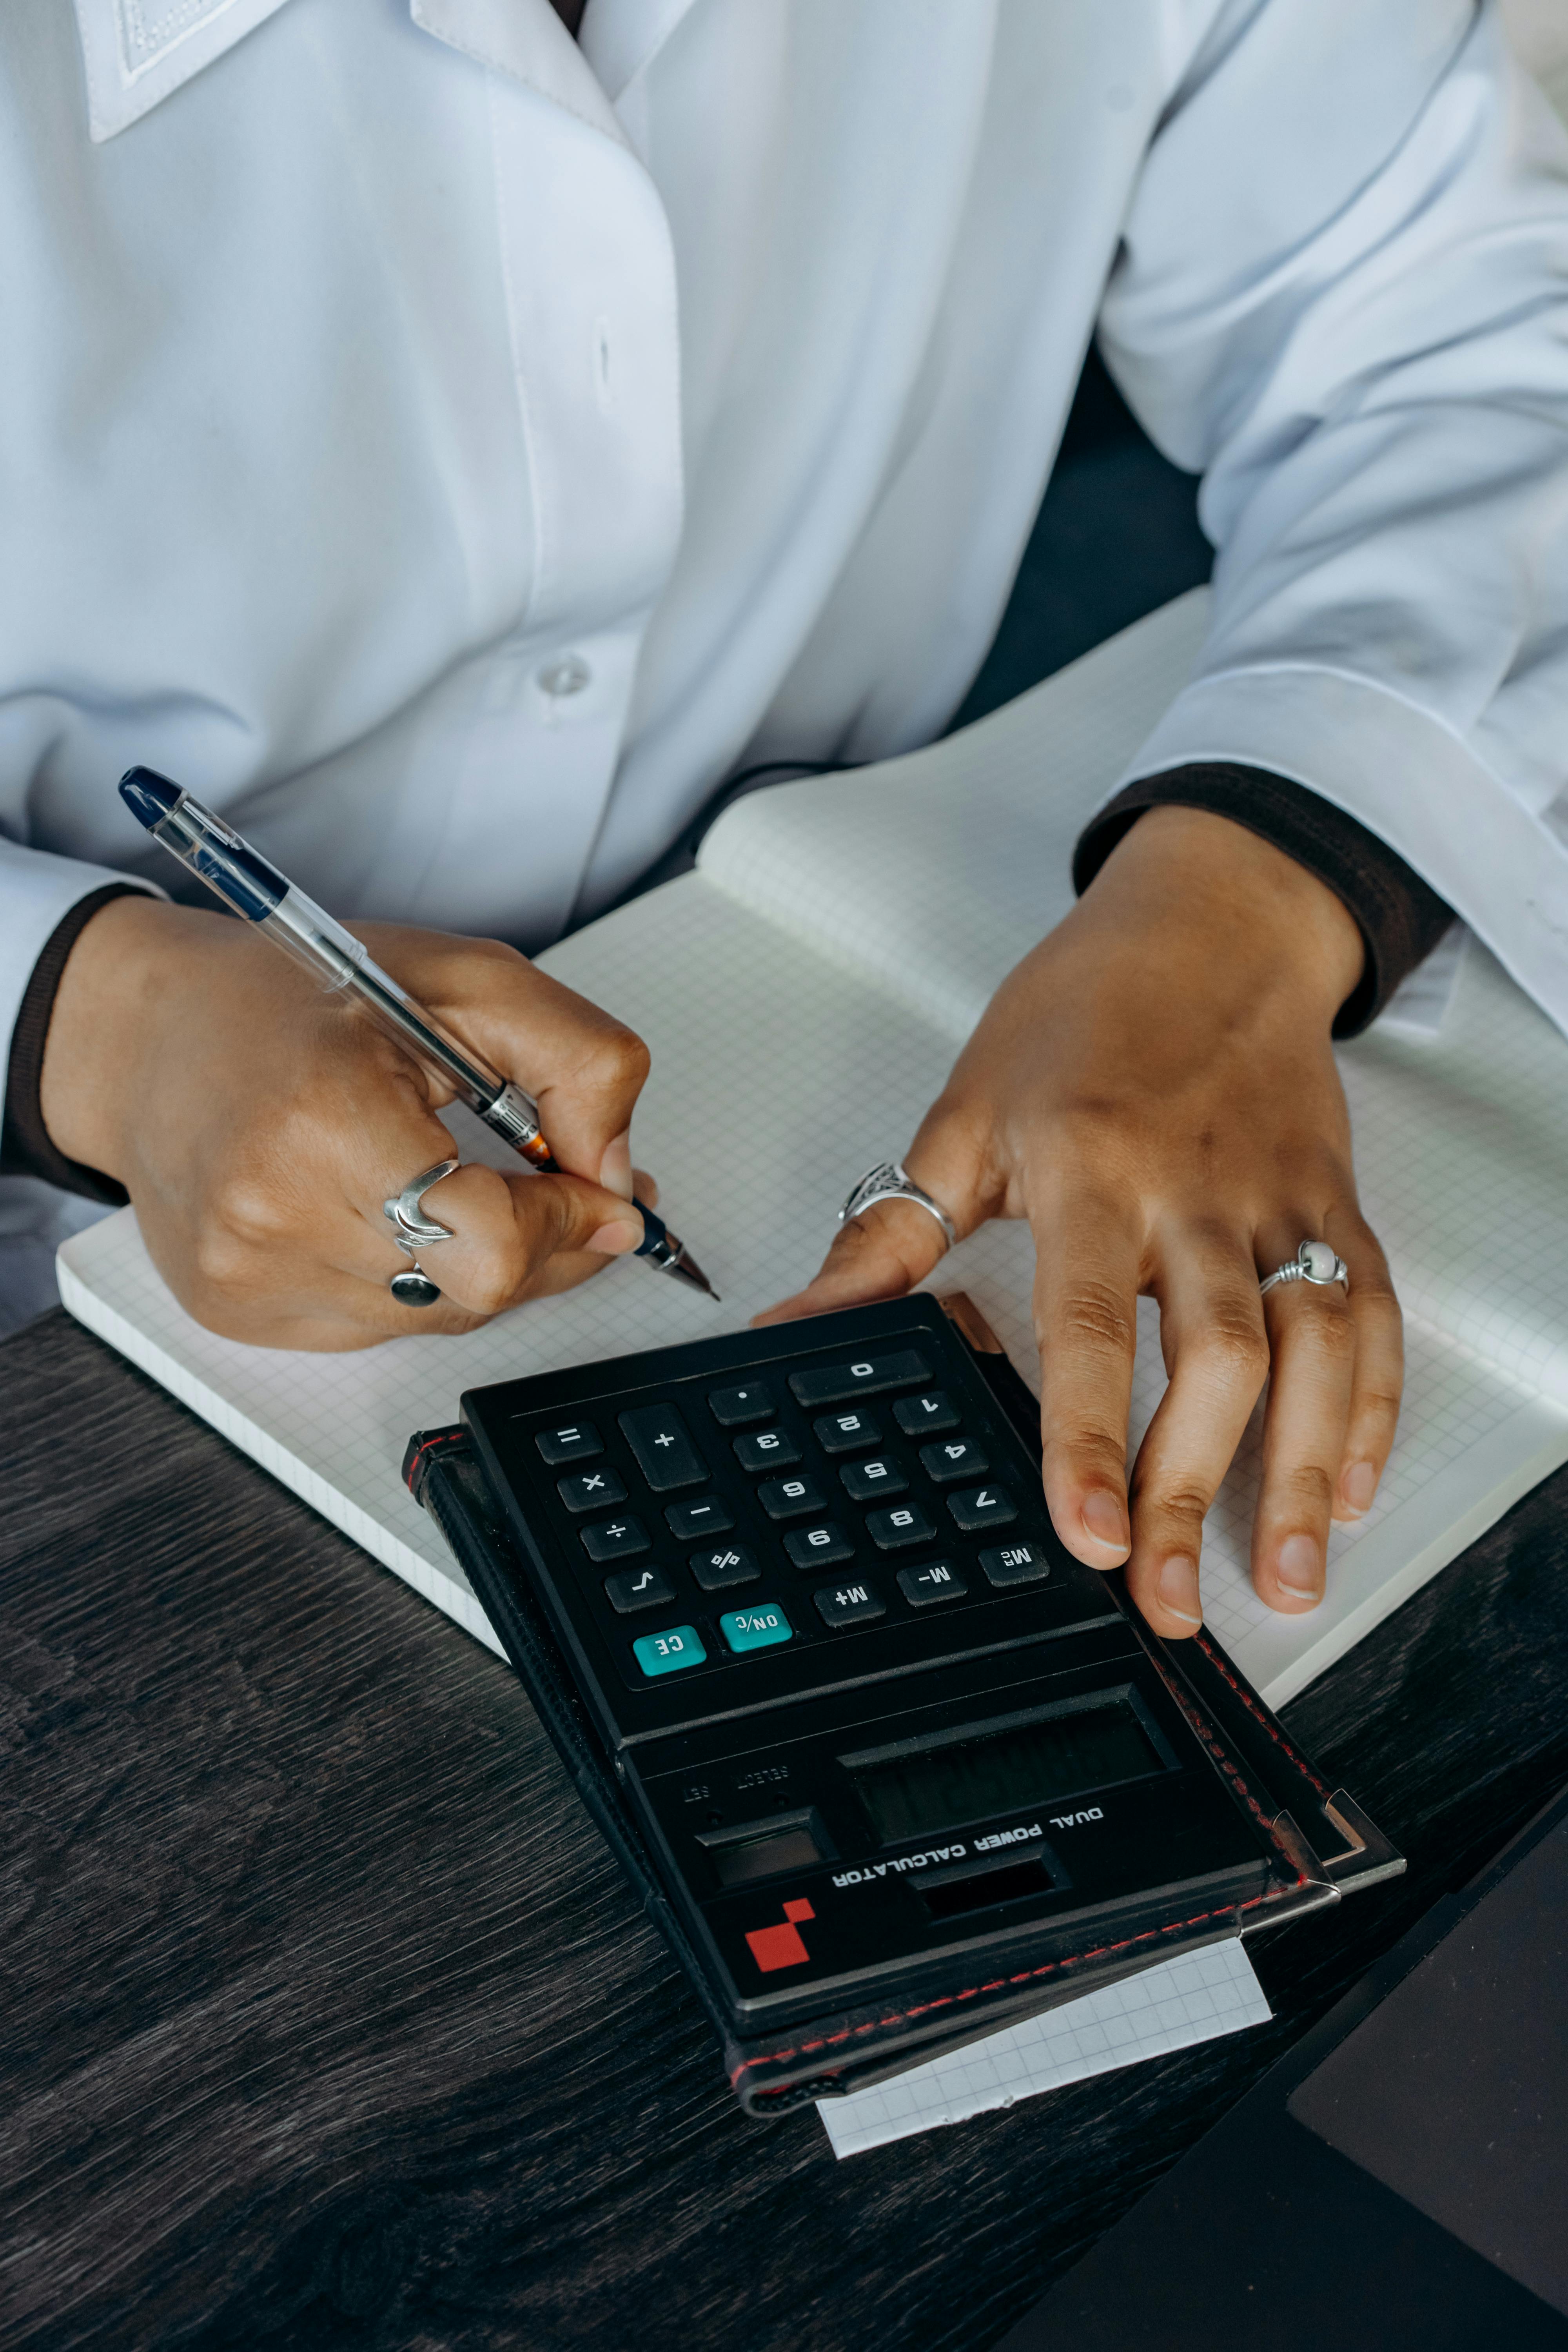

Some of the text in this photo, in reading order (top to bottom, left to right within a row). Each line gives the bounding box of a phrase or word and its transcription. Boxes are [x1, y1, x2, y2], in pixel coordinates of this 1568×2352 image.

[851, 1363, 874, 1376] 0
[921, 1399, 938, 1412] 1
[837, 1416, 860, 1431] 2
[557, 1428, 581, 1443] =
[654, 1434, 674, 1446] +
[757, 1434, 779, 1449] 3
[944, 1445, 966, 1459] 4
[864, 1463, 887, 1479] 5
[782, 1482, 805, 1497] 6
[976, 1491, 996, 1507] 7
[890, 1510, 913, 1526] 8
[606, 1524, 626, 1537] ÷
[808, 1530, 831, 1546] 9
[711, 1551, 740, 1569] %
[835, 1586, 868, 1605] M+
[735, 1615, 778, 1632] ON/C
[655, 1635, 684, 1655] CE
[737, 1766, 789, 1789] SELECT
[683, 1786, 710, 1802] SET
[832, 1808, 1104, 1887] DUAL POWER CALCULATOR
